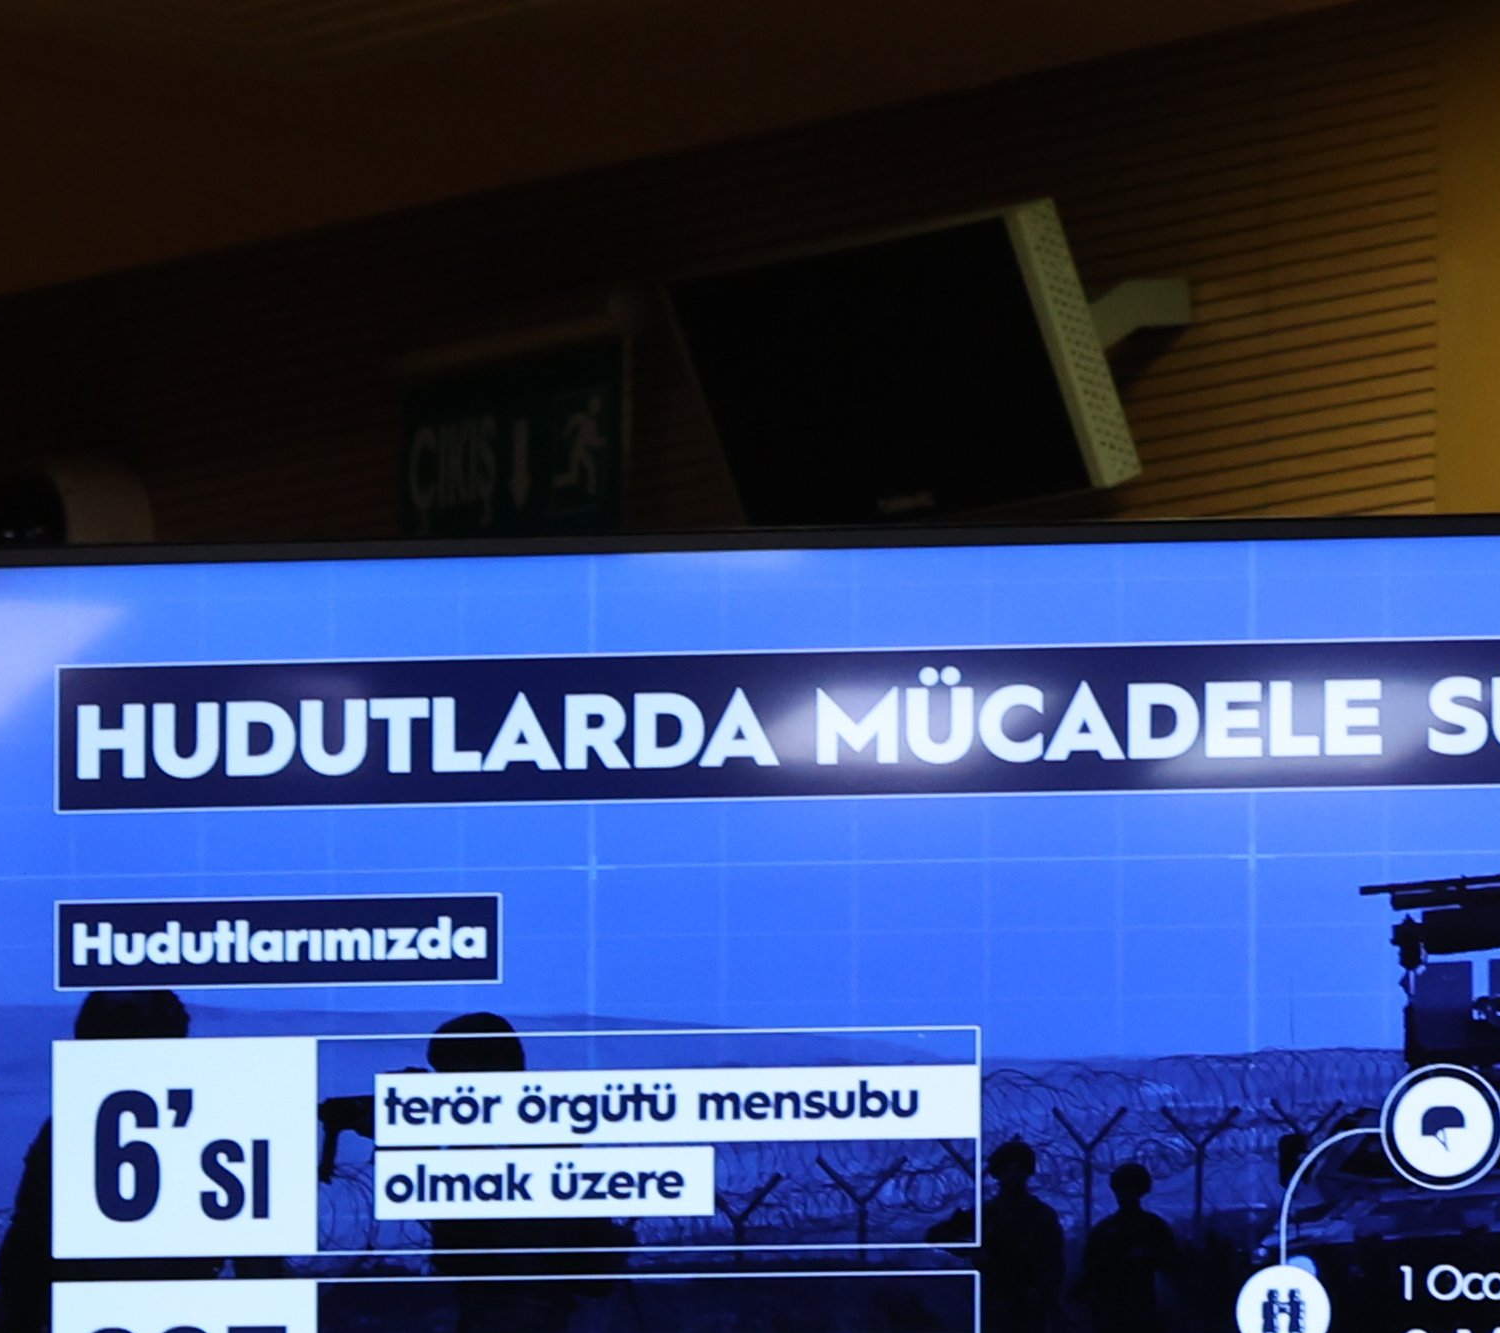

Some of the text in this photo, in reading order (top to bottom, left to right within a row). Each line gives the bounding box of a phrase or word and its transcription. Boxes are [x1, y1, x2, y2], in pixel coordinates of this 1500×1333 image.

[75, 686, 780, 780] HUDUTLARDA
[815, 665, 1384, 766] MÜCADELE
[71, 914, 488, 967] Hudutlarımızda
[383, 1079, 920, 1134] terör örgütü mensubu
[384, 1161, 685, 1204] olmak üzere
[1399, 1264, 1413, 1301] 1
